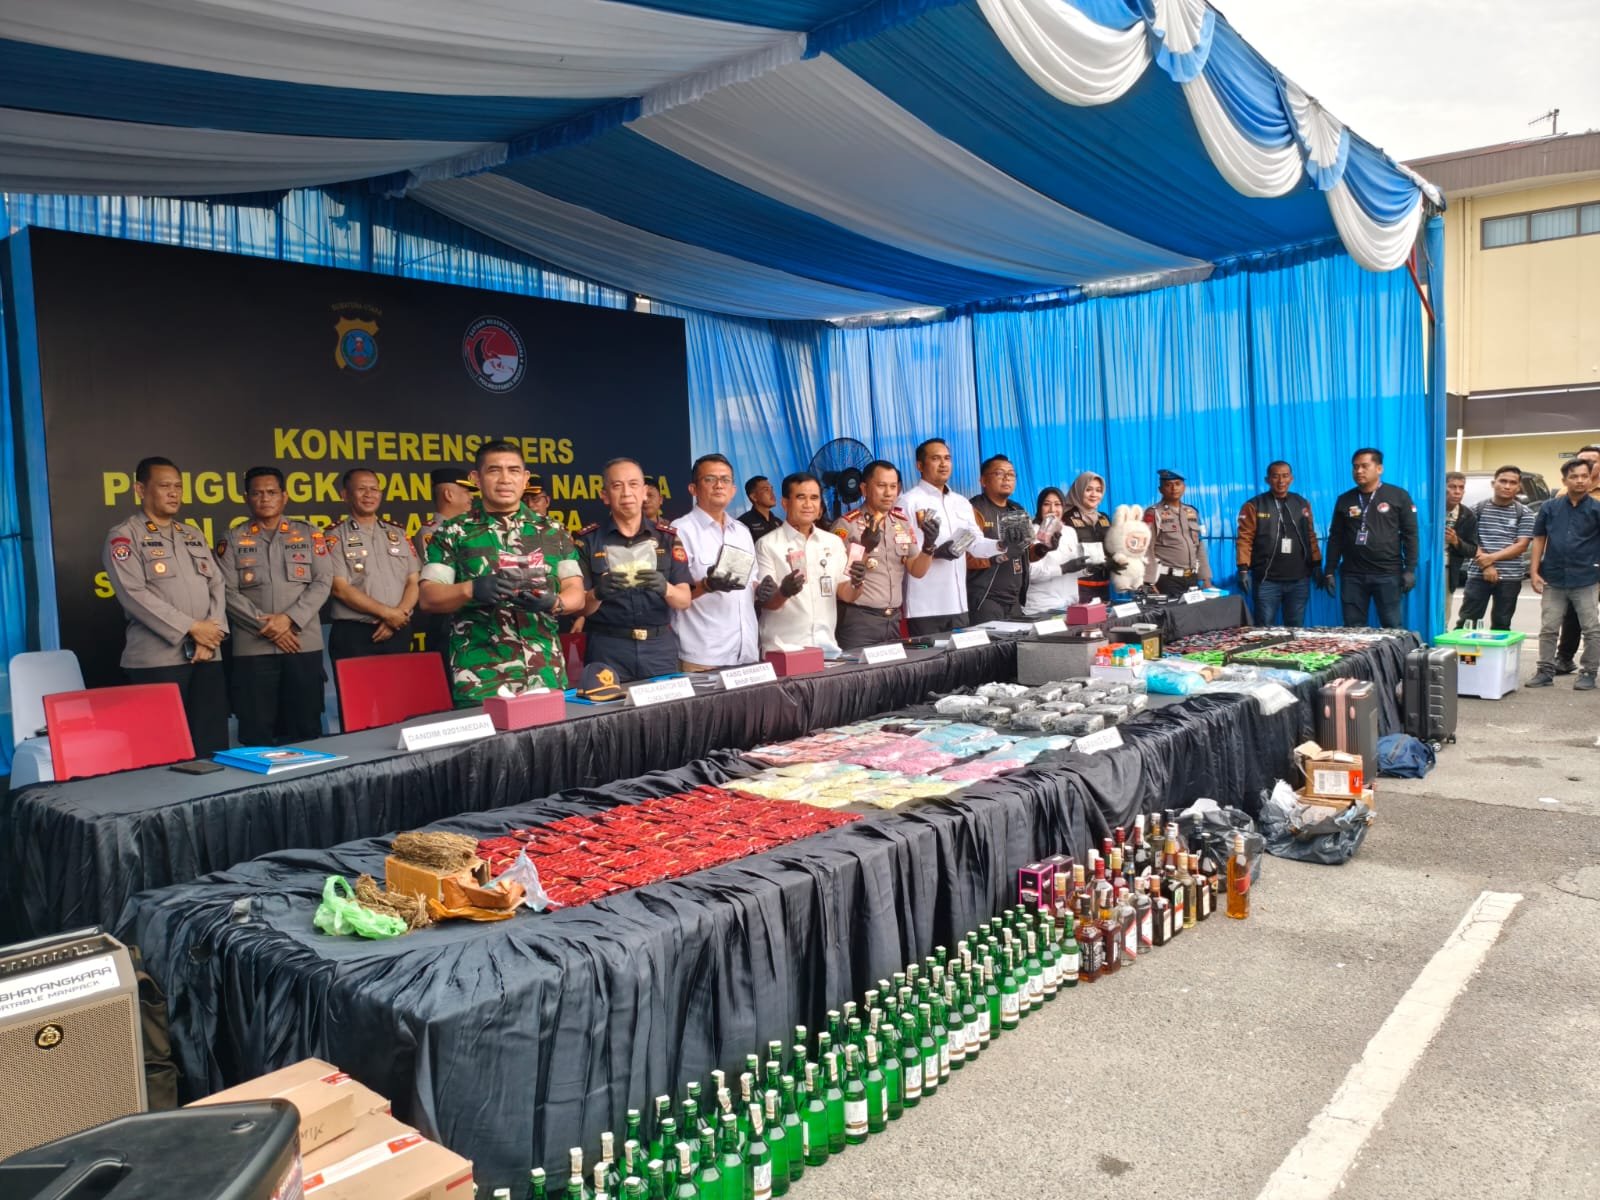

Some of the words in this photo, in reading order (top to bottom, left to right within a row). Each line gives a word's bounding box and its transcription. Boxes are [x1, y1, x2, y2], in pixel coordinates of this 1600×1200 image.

[408, 728, 442, 742] DANDIM
[0, 995, 44, 1011] RTABLE
[47, 980, 100, 999] MANPACK
